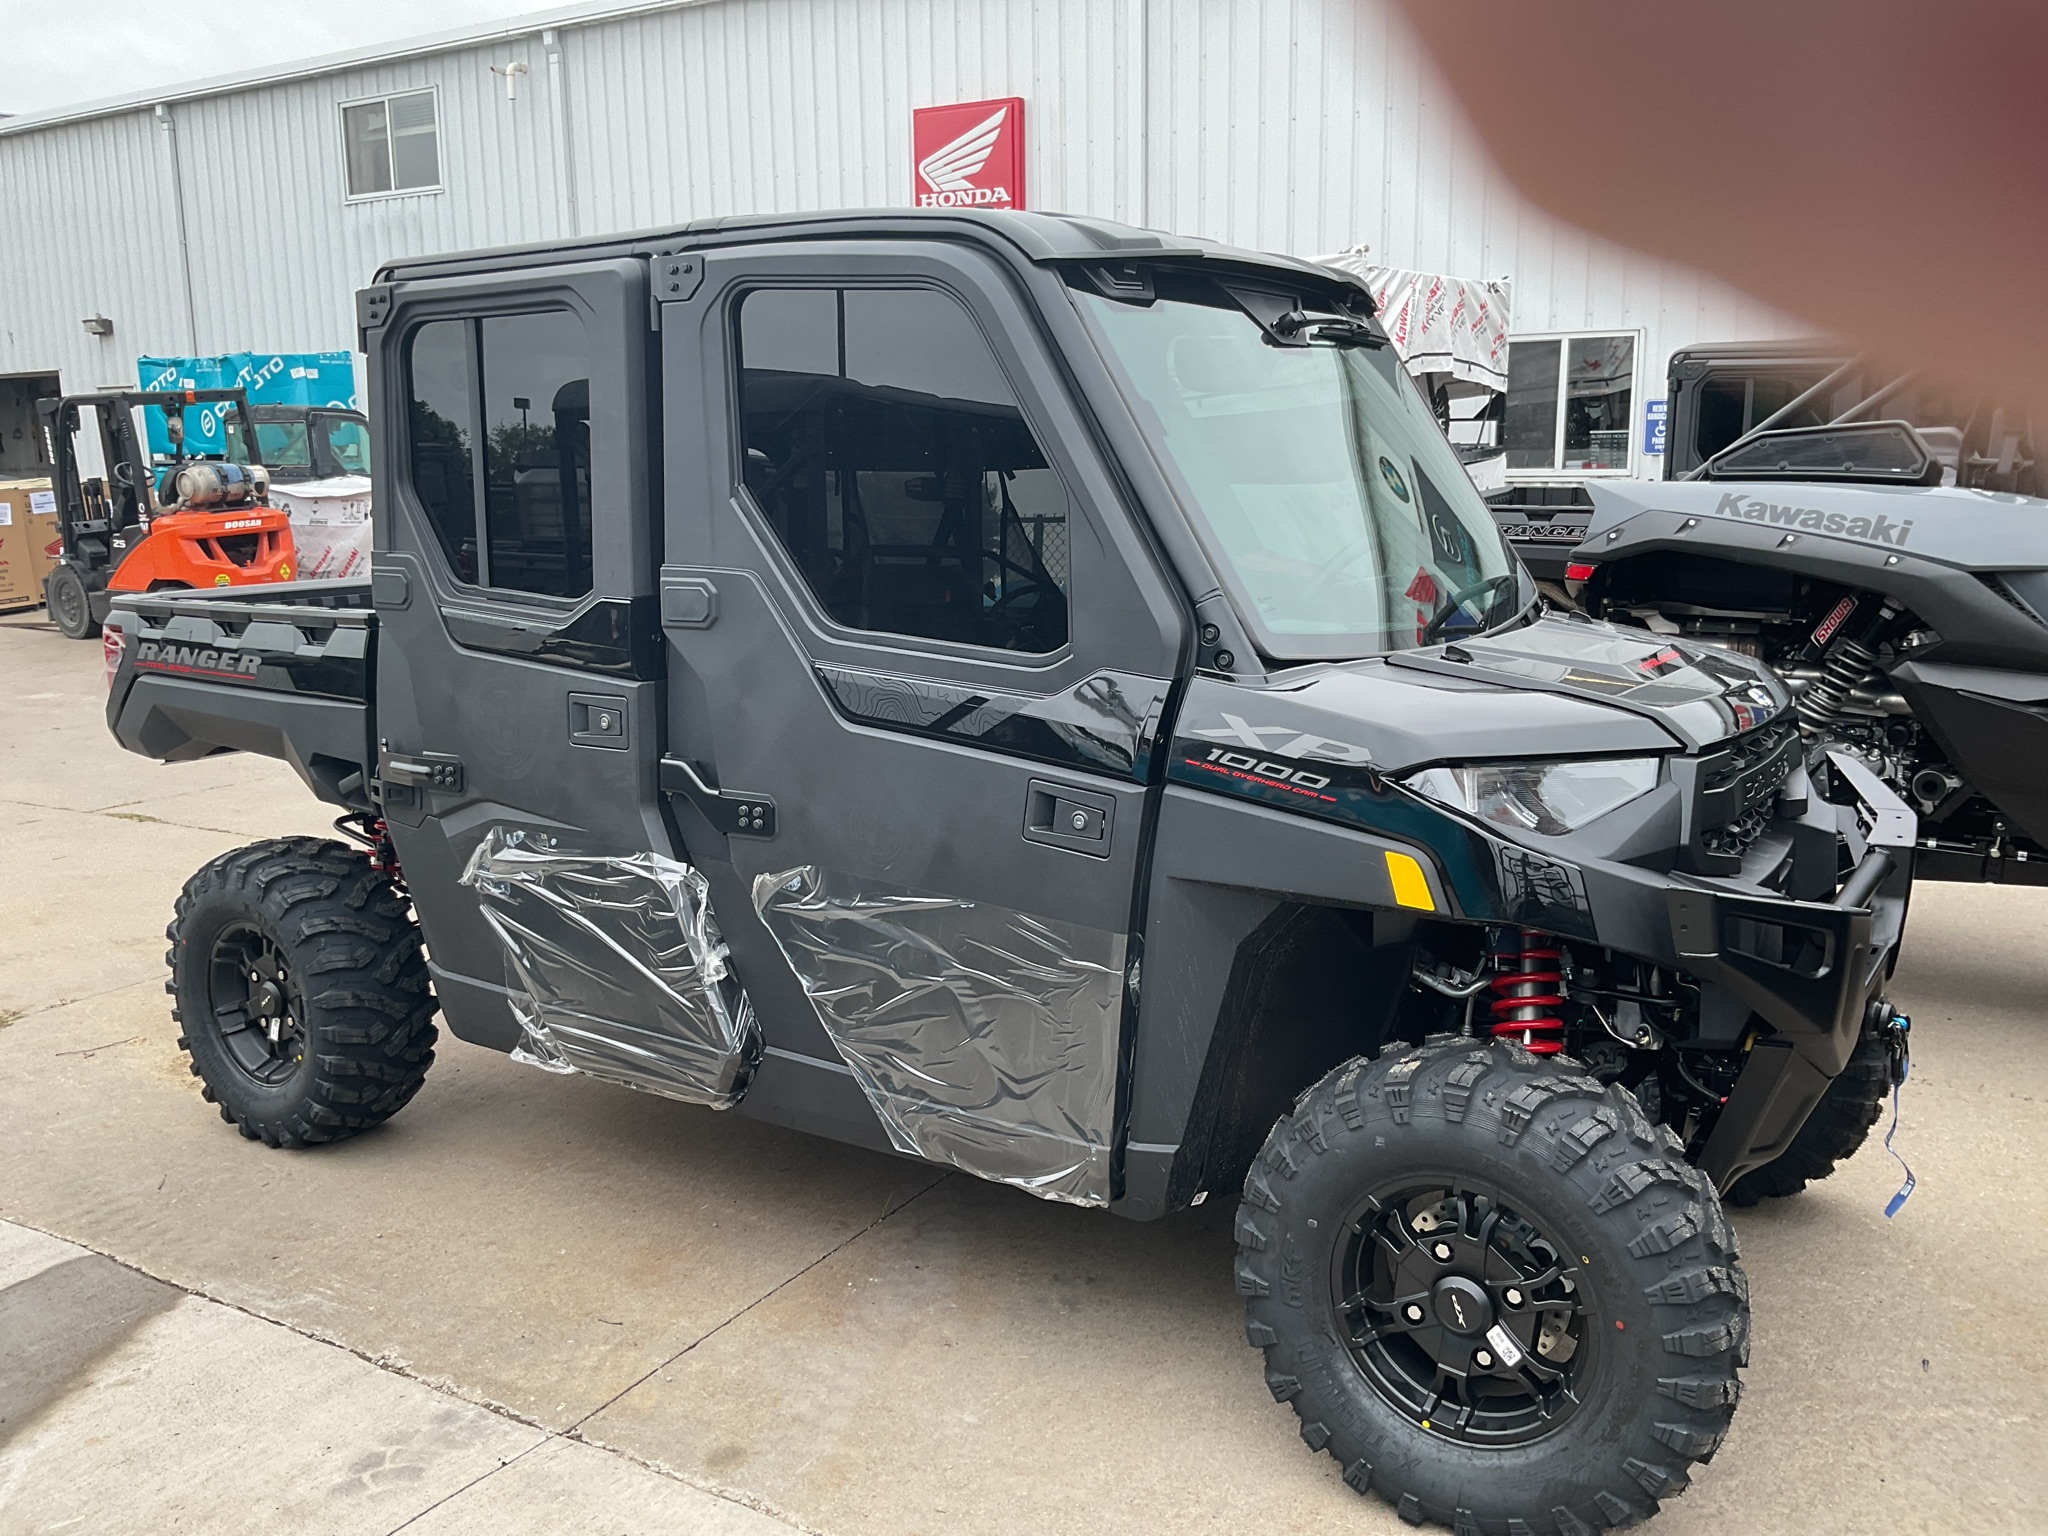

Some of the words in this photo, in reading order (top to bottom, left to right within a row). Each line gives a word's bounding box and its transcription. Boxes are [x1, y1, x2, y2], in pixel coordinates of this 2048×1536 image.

[919, 187, 1011, 208] HONDA
[224, 519, 262, 529] DOOSAN
[1499, 524, 1588, 538] RANGE
[1714, 492, 1914, 548] Kawasaki
[1815, 597, 1853, 645] SHOWA
[136, 642, 262, 674] RANGER
[1190, 712, 1373, 762] XP
[1201, 763, 1230, 775] DUAL
[1232, 771, 1291, 791] OVERHEAD
[1292, 787, 1319, 798] CAM
[1206, 748, 1331, 790] 1000
